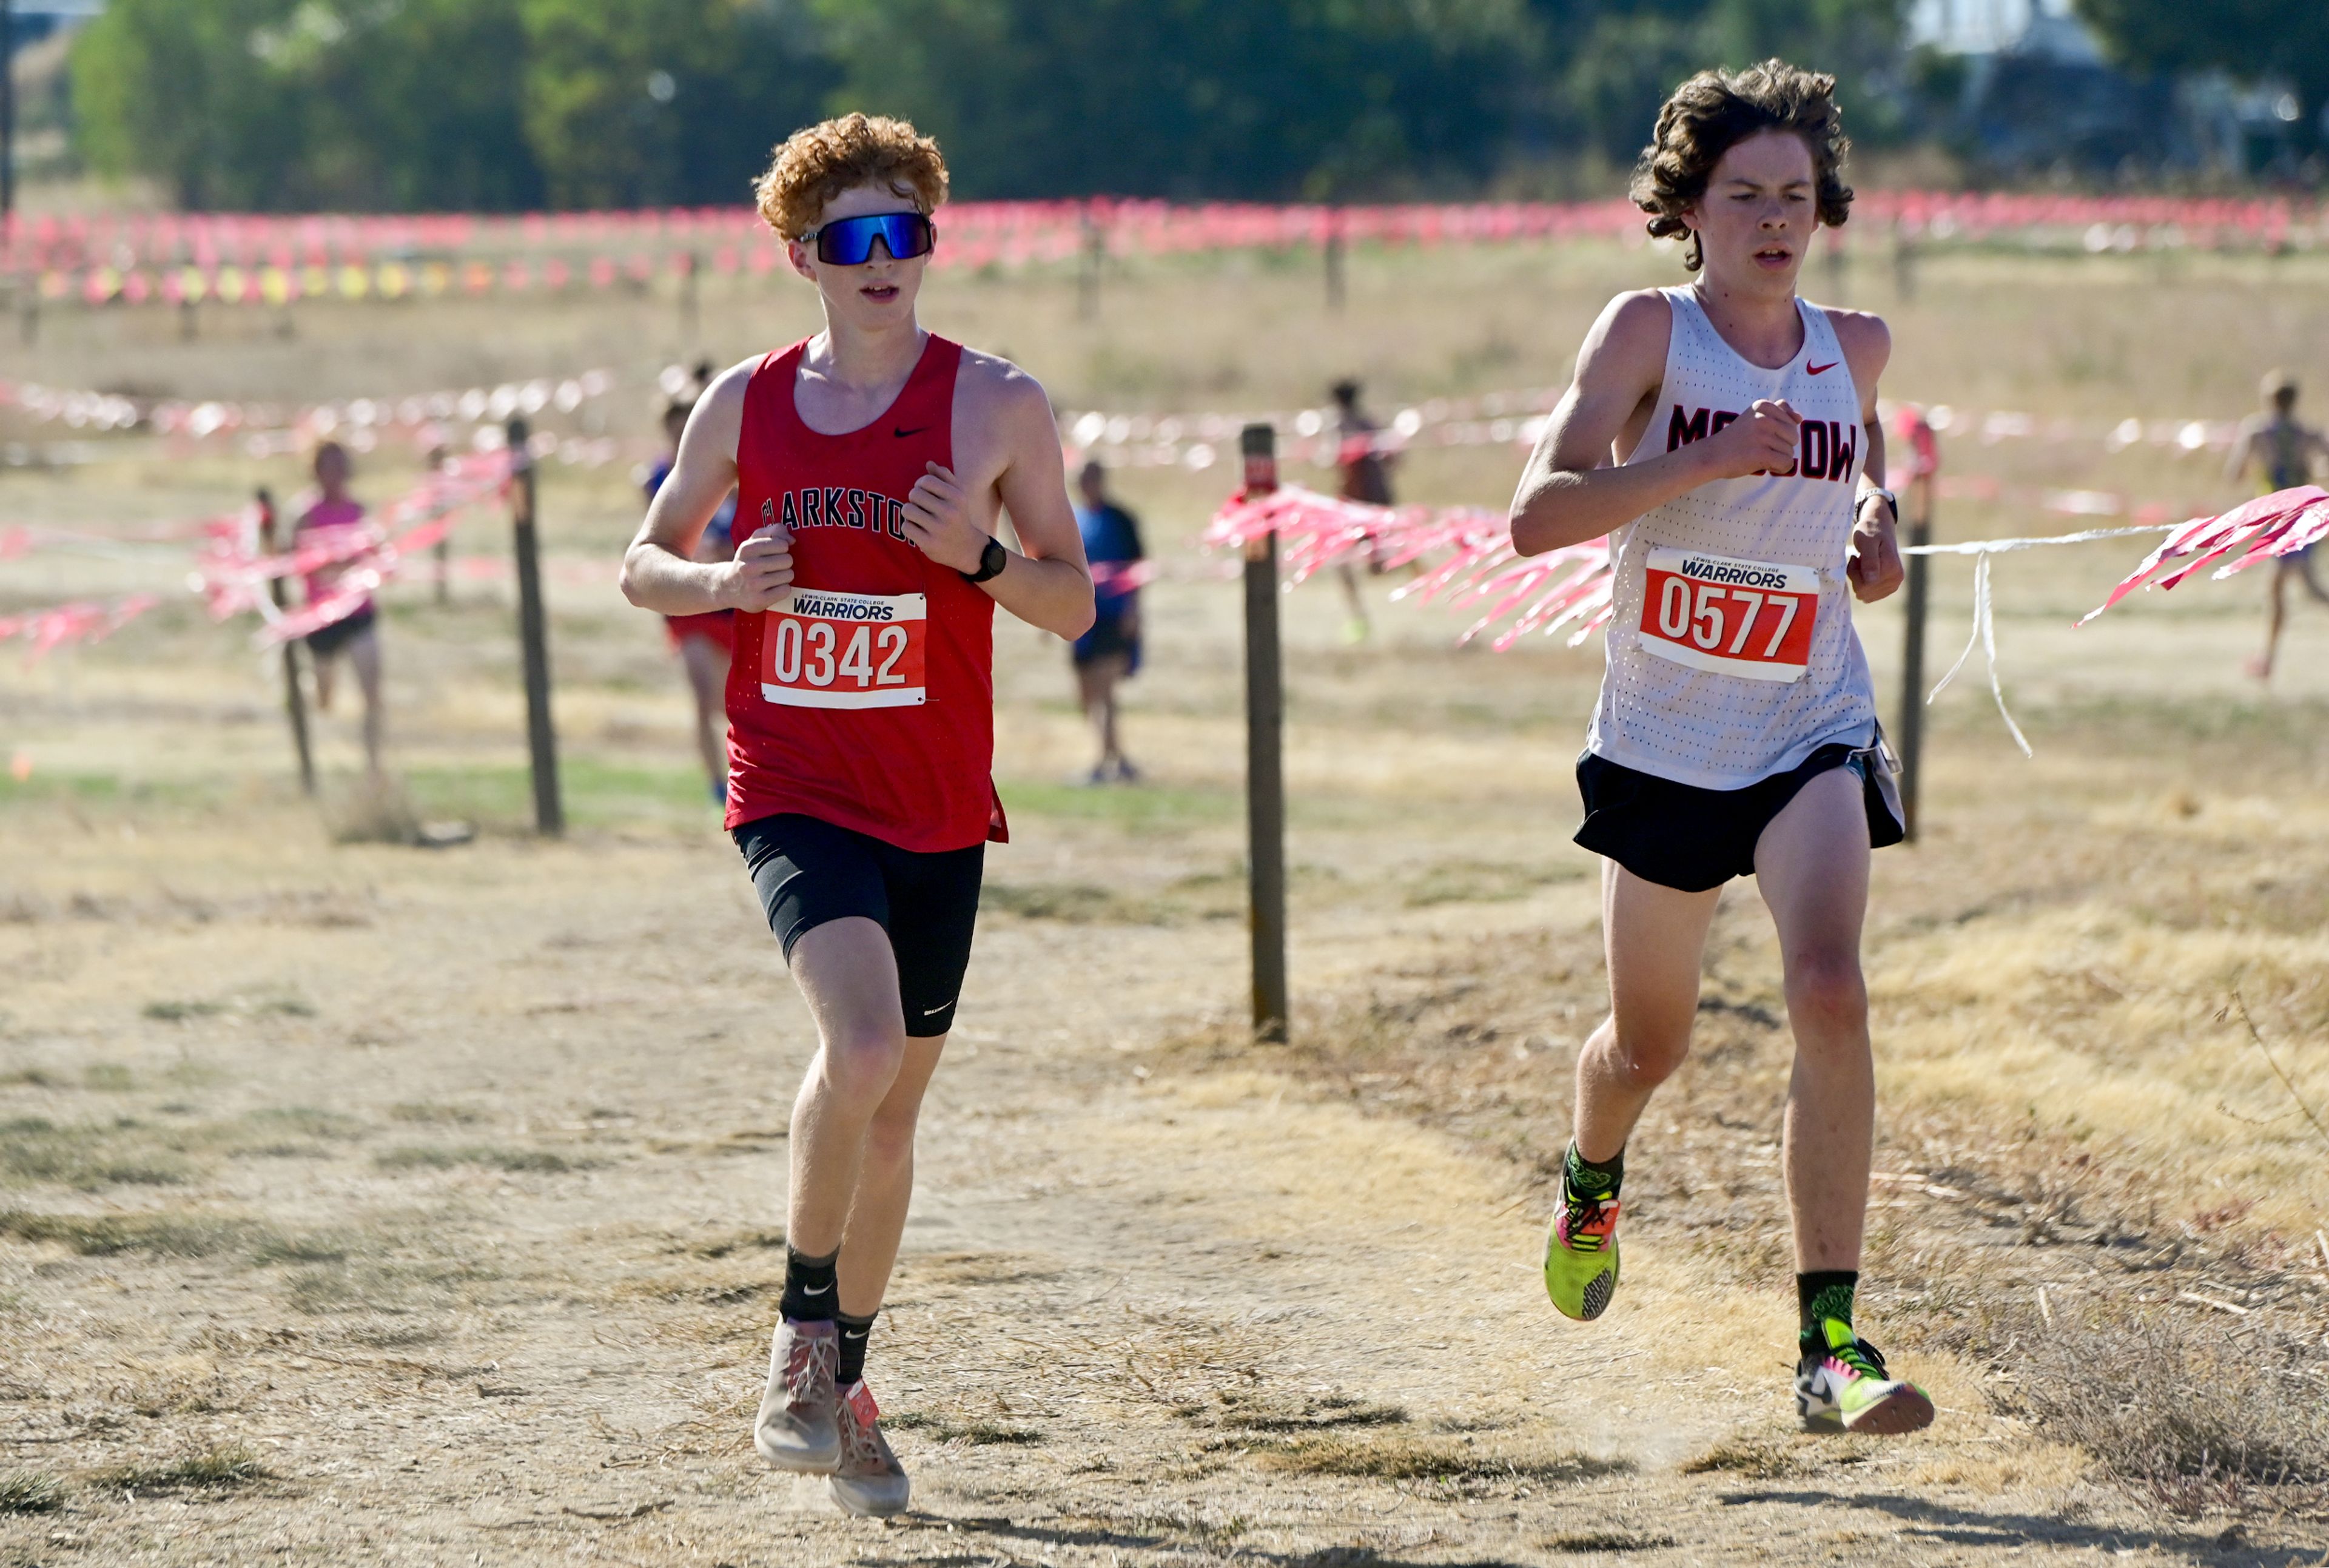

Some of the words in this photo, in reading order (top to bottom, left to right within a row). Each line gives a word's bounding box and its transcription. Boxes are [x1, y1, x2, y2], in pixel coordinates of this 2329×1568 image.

[1667, 404, 1857, 483] MOW
[761, 487, 916, 547] CLARKSTO
[1681, 559, 1787, 589] WARRIORS
[1693, 556, 1732, 567] LEWIS-CLARK
[793, 597, 894, 621] WARRIORS
[801, 593, 838, 602] LEWIS-CLARK
[1659, 576, 1799, 658] 0577
[775, 618, 908, 687] 0342
